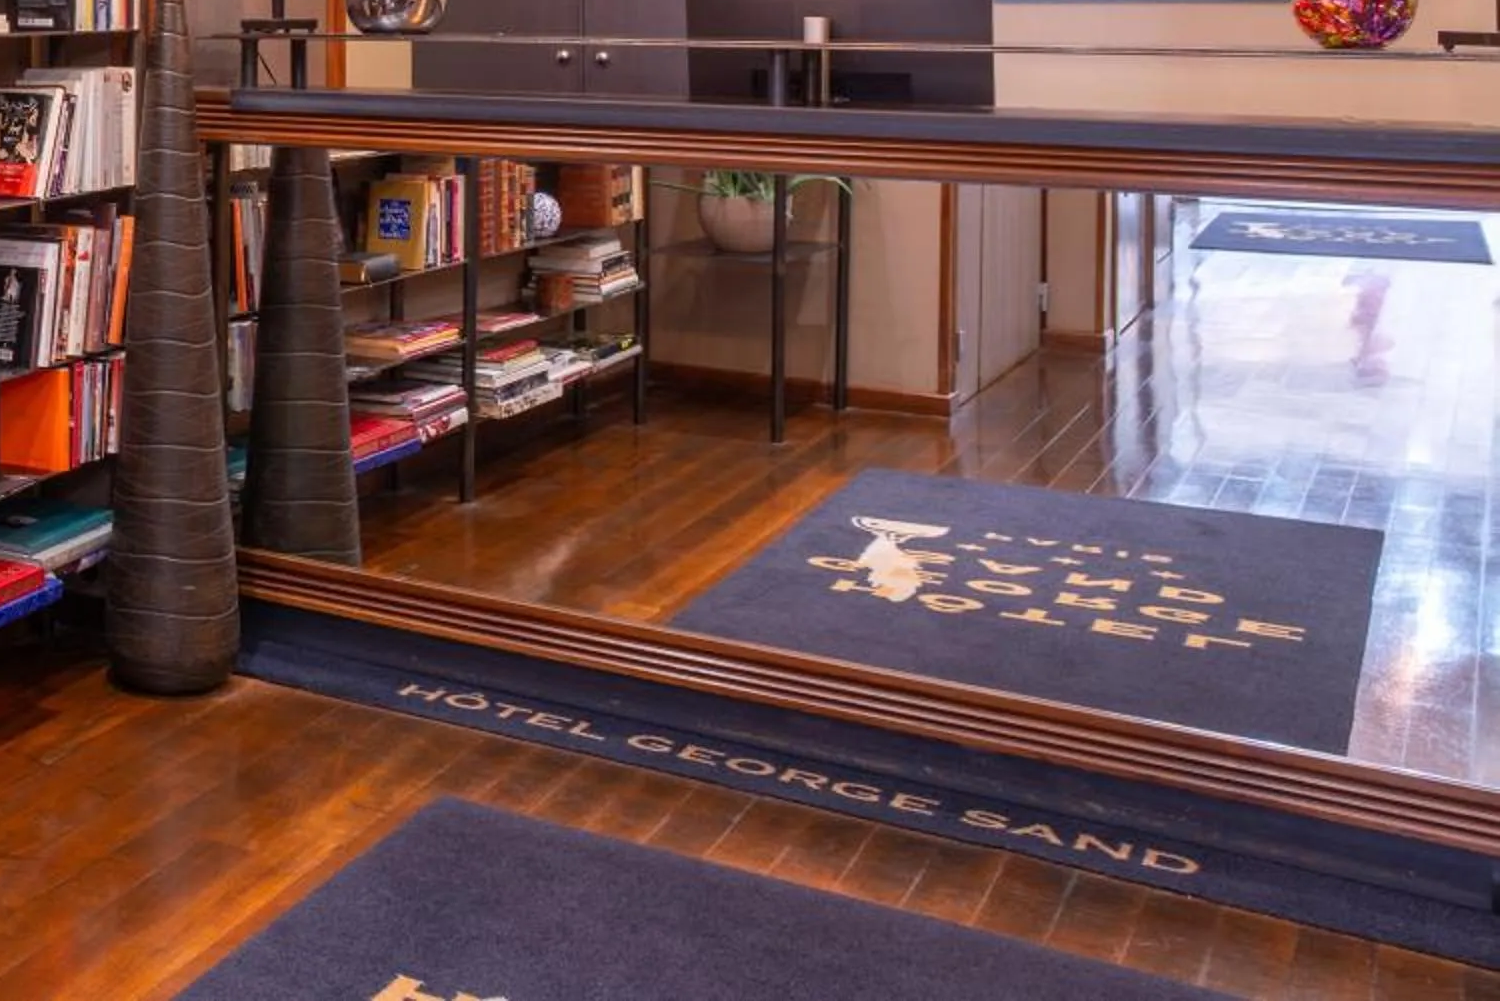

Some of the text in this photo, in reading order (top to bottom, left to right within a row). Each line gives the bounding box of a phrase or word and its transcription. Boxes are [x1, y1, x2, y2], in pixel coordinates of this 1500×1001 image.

[396, 682, 1202, 877] HÔTEL GEORGE SAND
